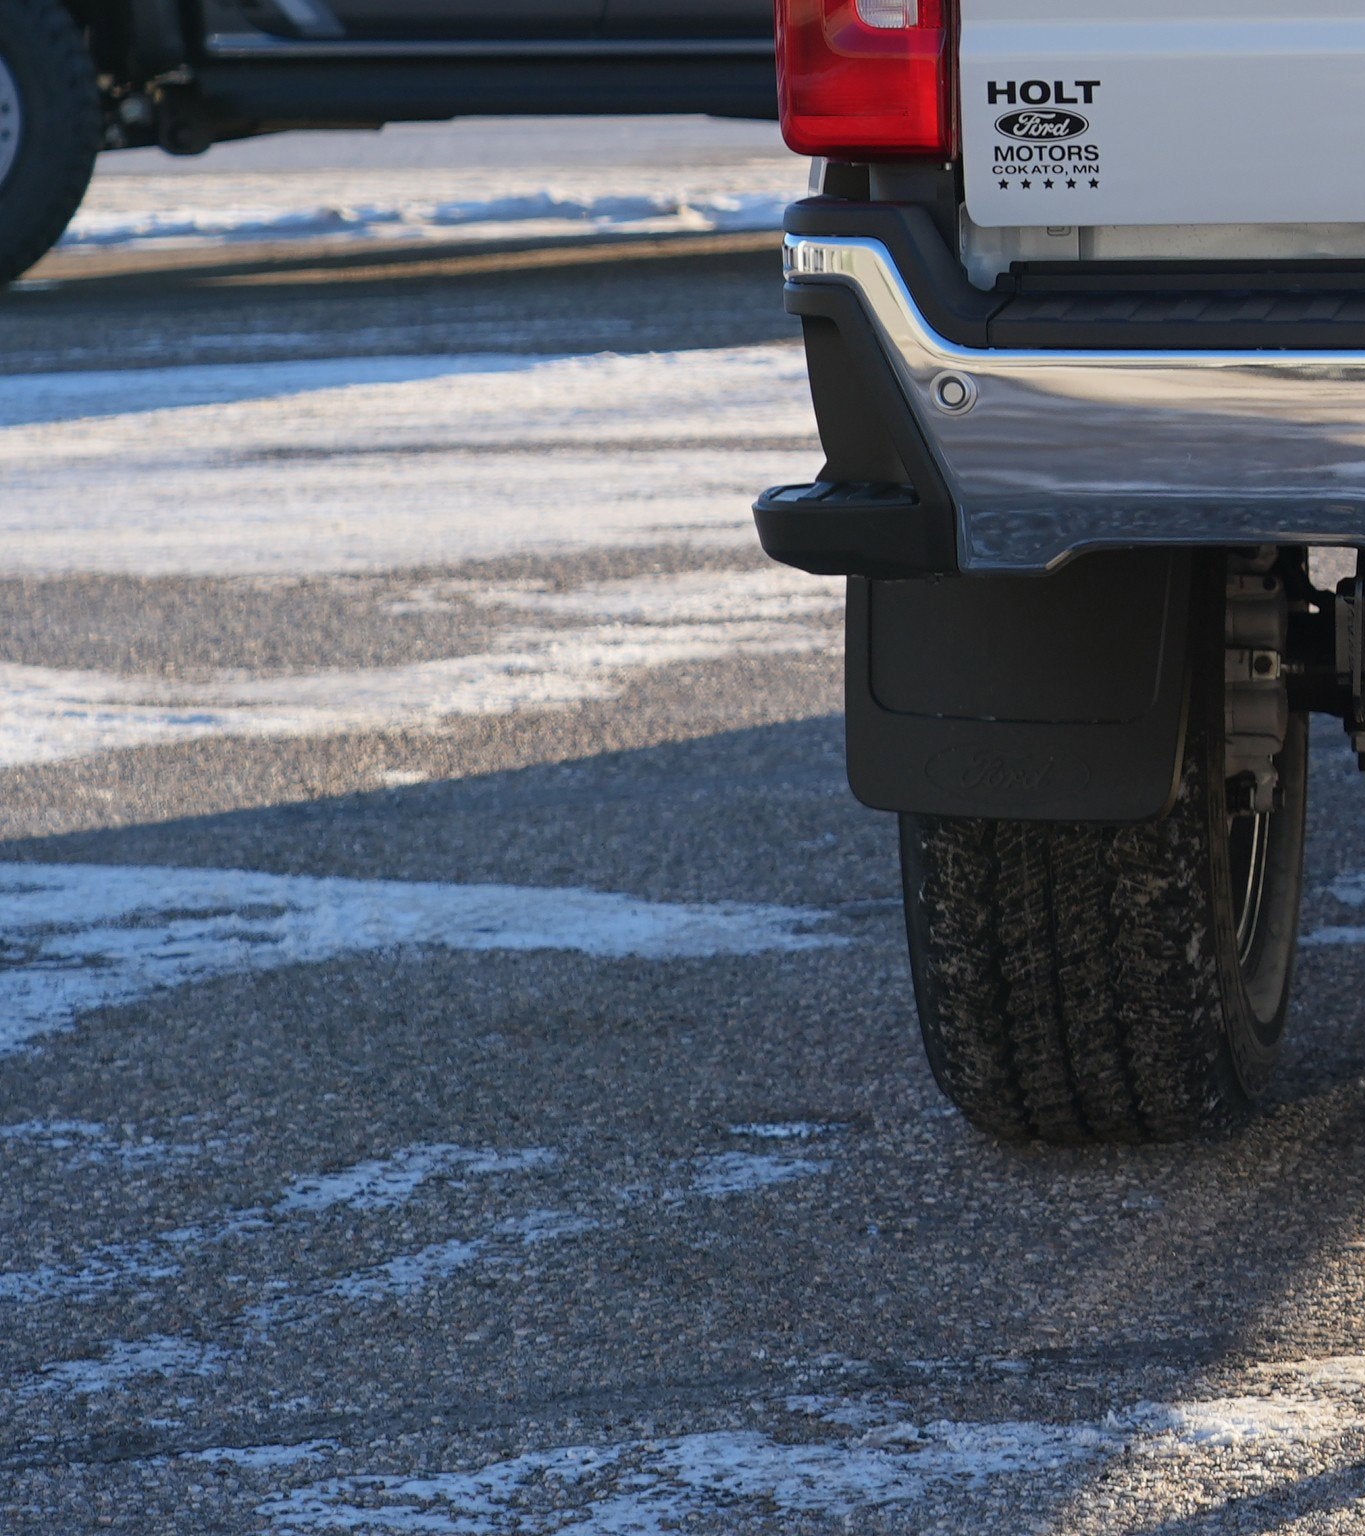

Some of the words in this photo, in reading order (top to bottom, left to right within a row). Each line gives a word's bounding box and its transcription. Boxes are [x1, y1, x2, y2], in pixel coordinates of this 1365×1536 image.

[987, 80, 1101, 105] HOLT
[1012, 112, 1071, 137] Ford
[993, 144, 1099, 162] MOTORS
[991, 164, 1068, 176] COKATO,
[1073, 164, 1100, 174] MN
